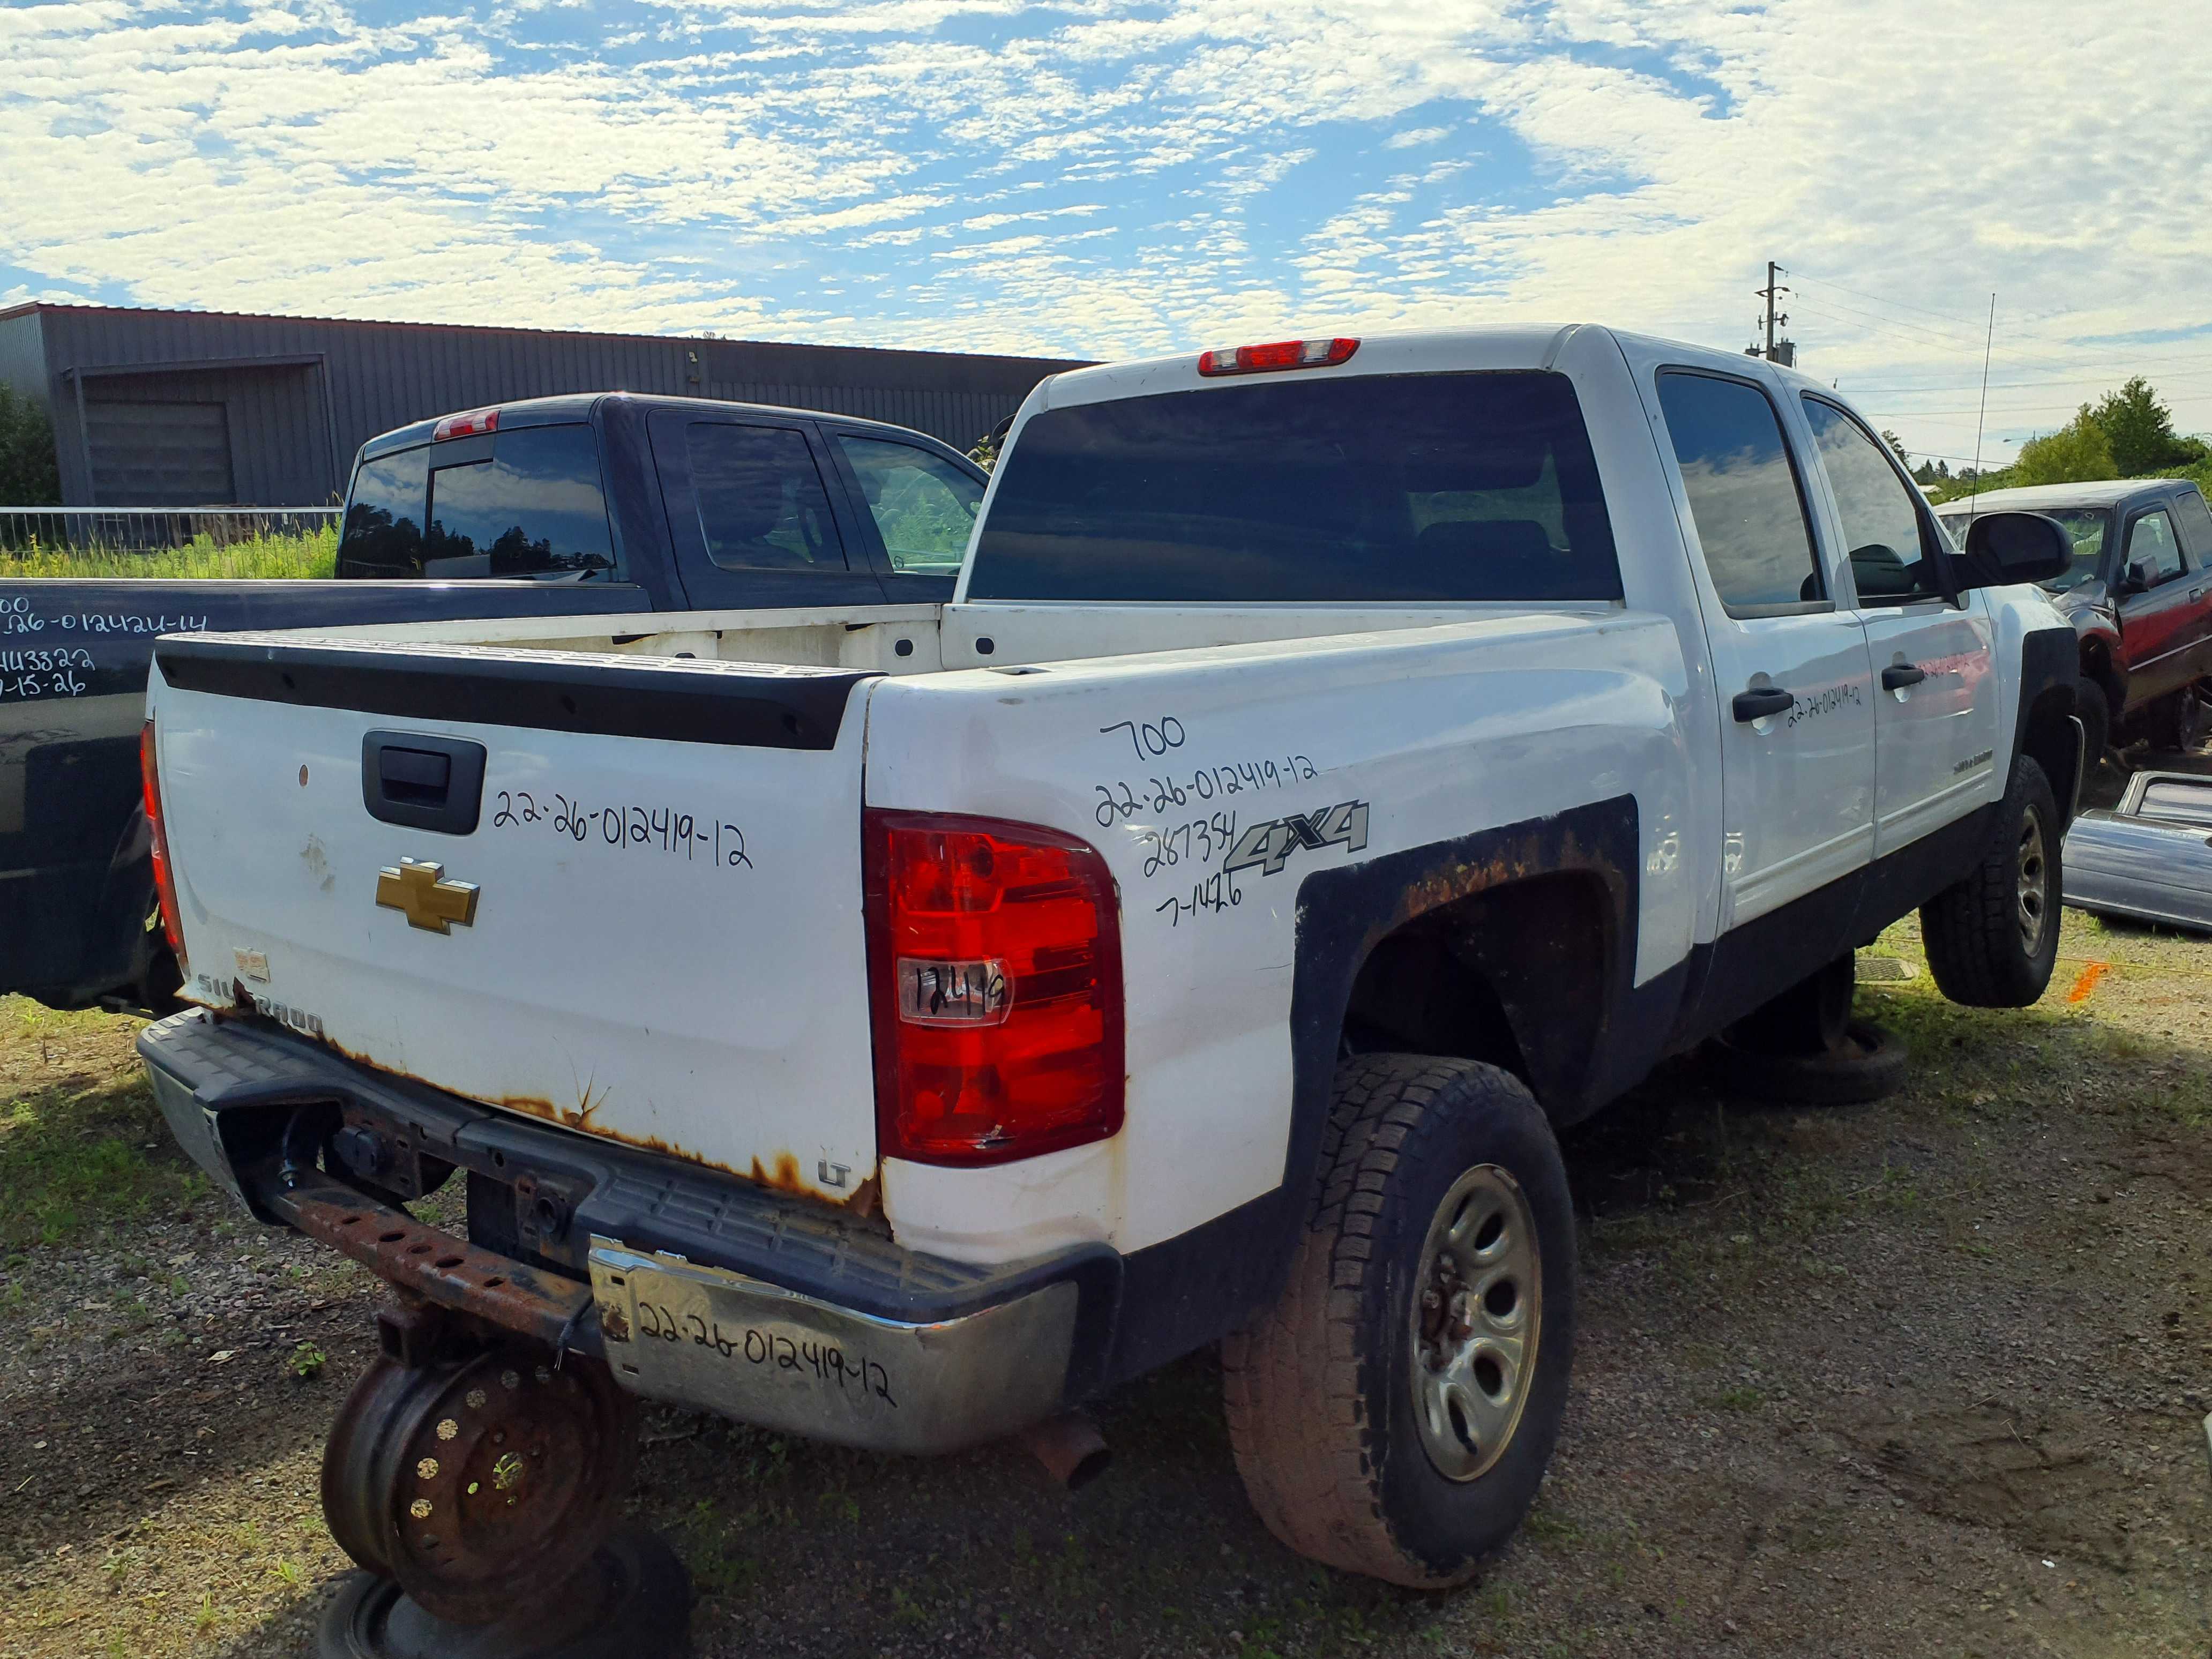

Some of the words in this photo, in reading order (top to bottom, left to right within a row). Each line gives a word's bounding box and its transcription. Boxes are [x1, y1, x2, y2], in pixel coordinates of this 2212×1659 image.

[1100, 716, 1185, 761] 700
[1144, 810, 1236, 878] 287354
[917, 966, 1005, 1029] 12419
[818, 1159, 851, 1188] LT
